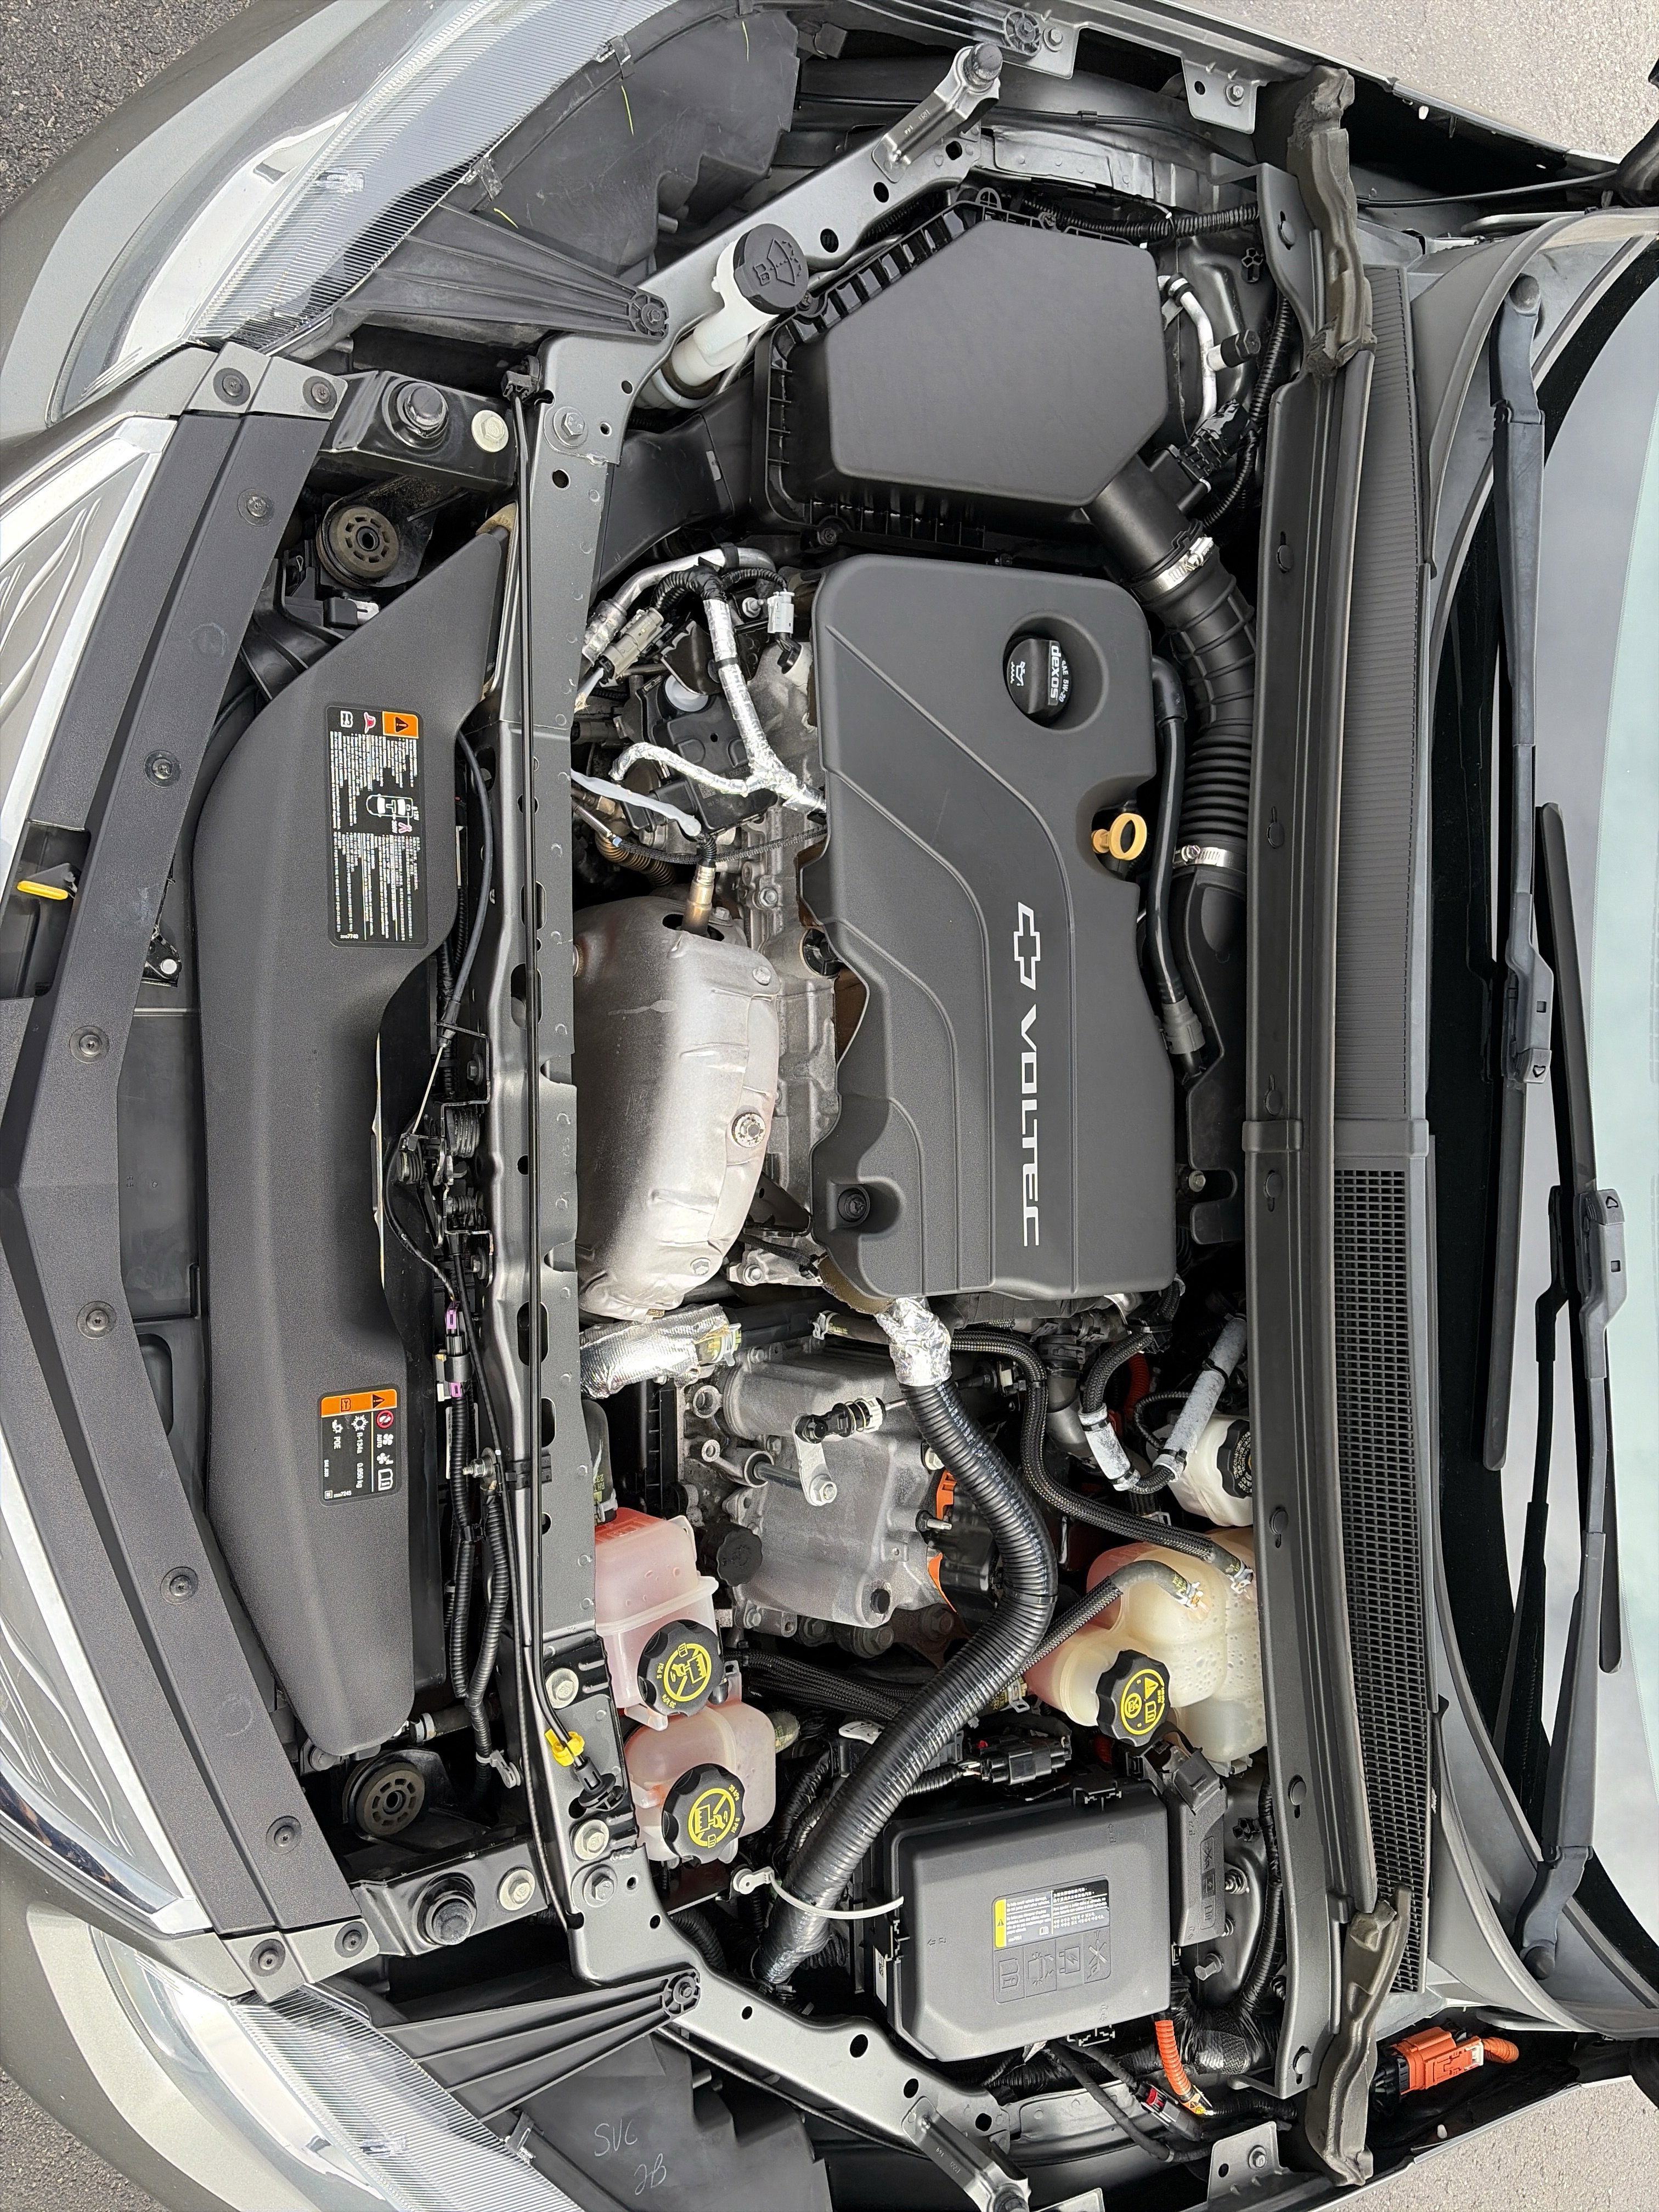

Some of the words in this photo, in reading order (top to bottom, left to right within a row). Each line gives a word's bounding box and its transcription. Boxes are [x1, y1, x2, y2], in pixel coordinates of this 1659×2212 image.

[1050, 645, 1062, 701] dexos
[1061, 660, 1069, 675] SAE
[1058, 679, 1069, 703] 5W-20
[1020, 1003, 1039, 1247] VOLTEC
[356, 1480, 364, 1488] kg
[657, 1662, 665, 1674] PSI
[662, 1694, 670, 1705] kPa
[729, 1784, 735, 1792] 35
[731, 1822, 739, 1833] PSI
[594, 2118, 638, 2157] SVC
